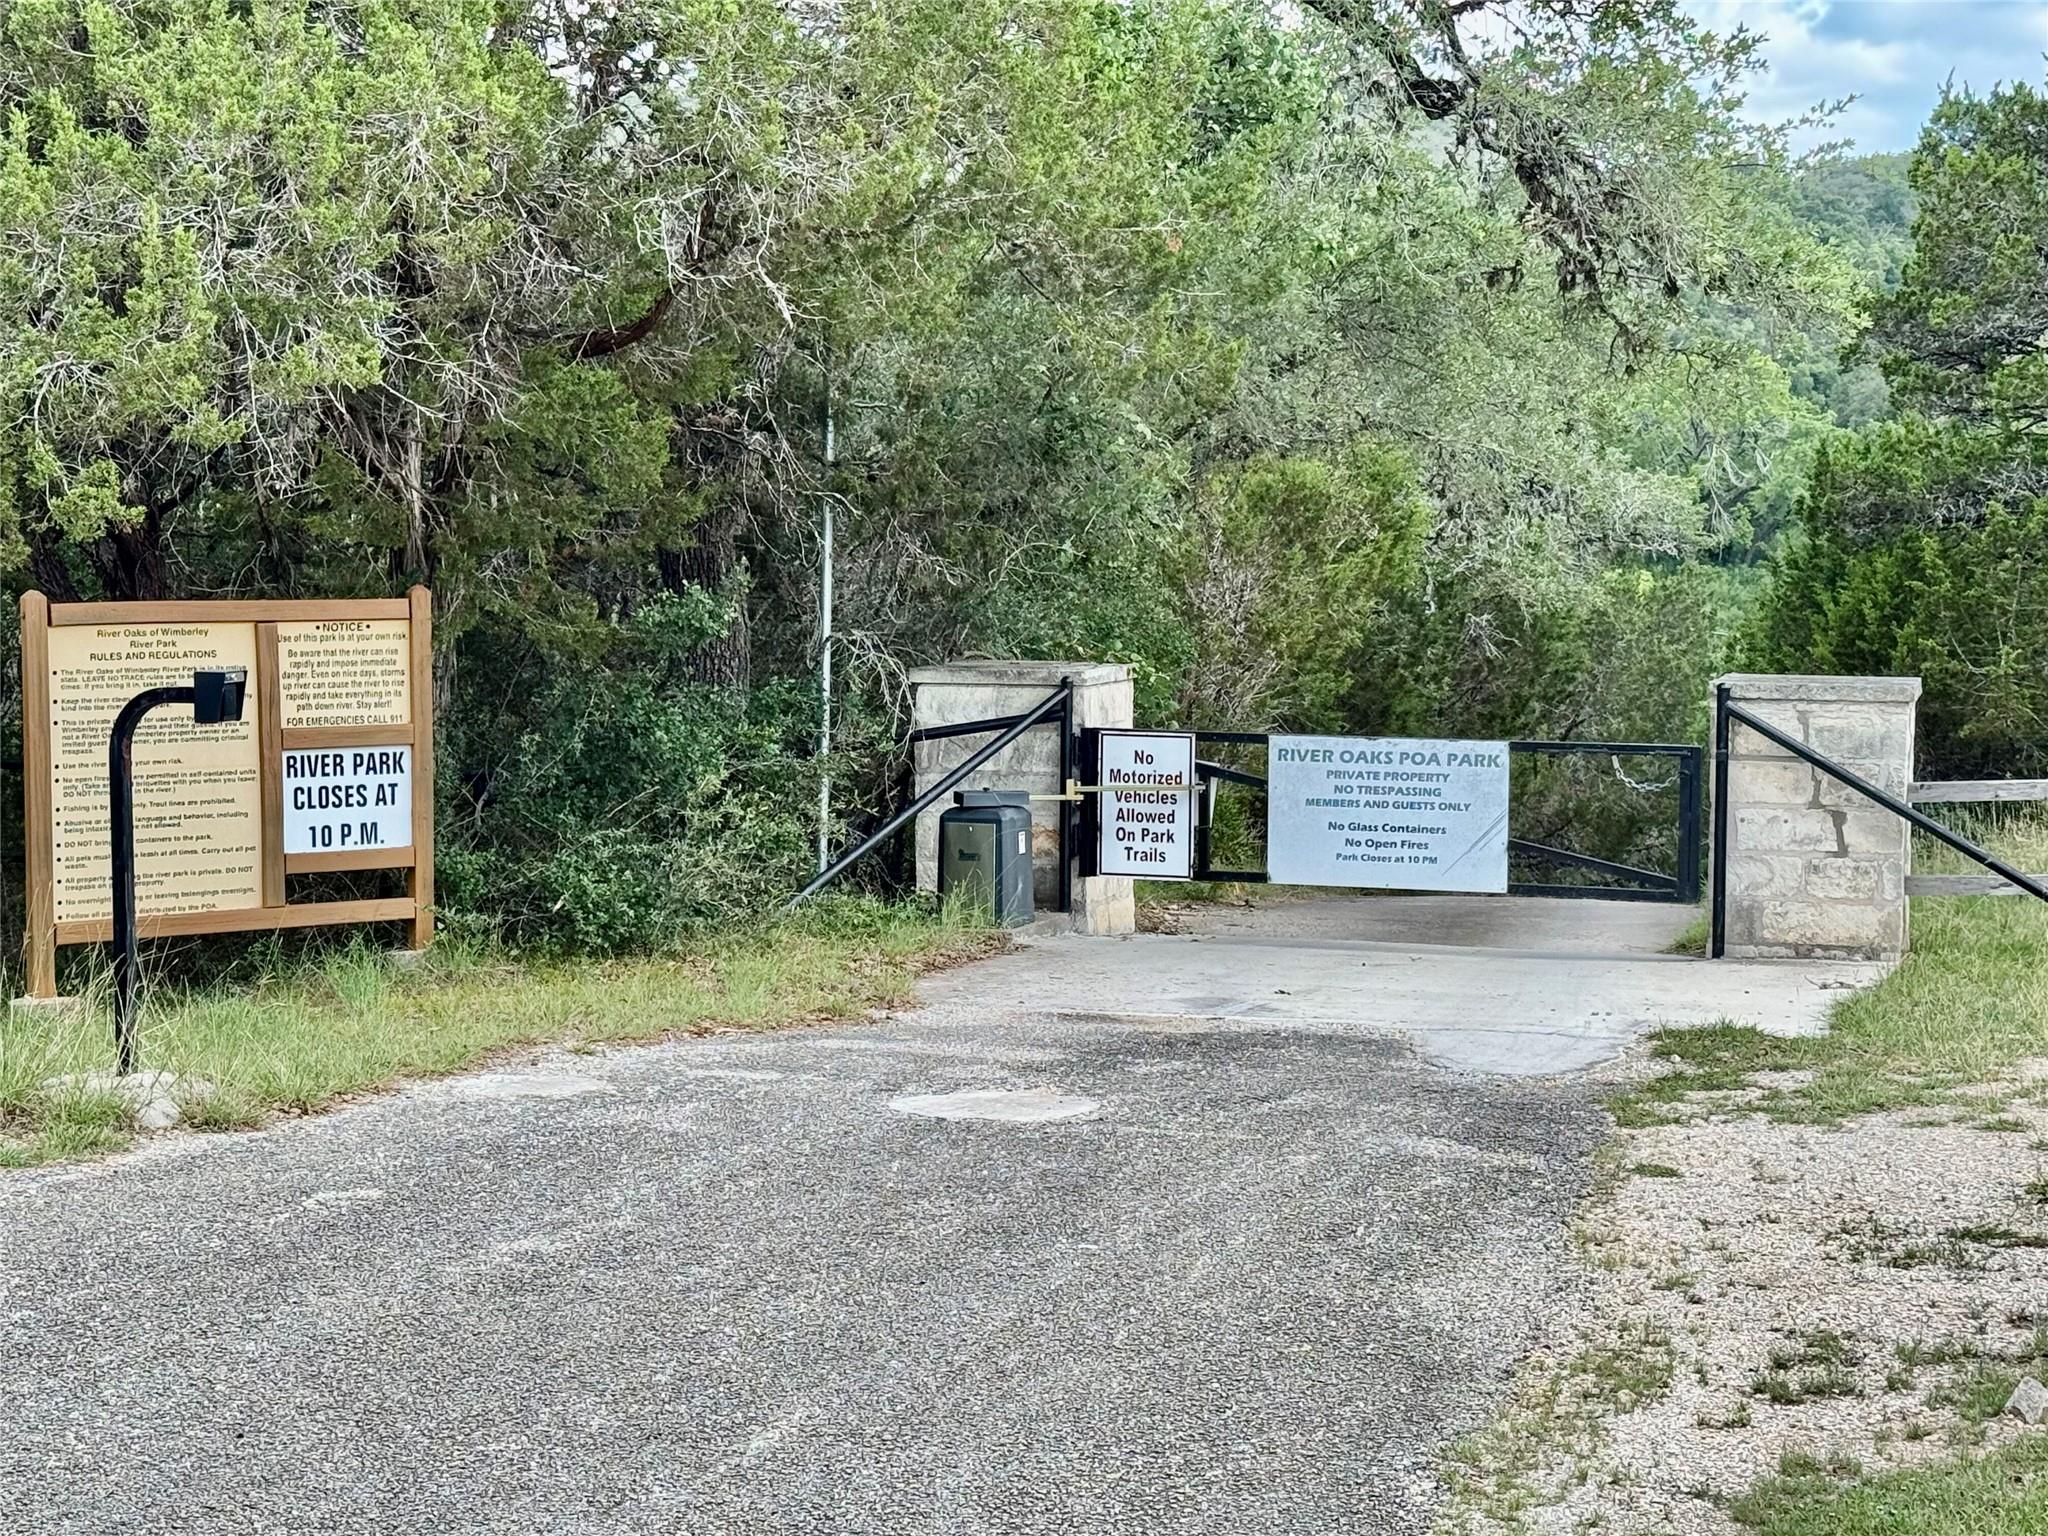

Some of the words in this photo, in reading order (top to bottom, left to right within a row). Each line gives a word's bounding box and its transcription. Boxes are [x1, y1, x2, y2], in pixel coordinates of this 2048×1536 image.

[323, 622, 364, 631] NOTICE
[97, 629, 121, 638] River
[124, 629, 147, 637] Oaks
[149, 628, 159, 636] of
[160, 628, 209, 637] Wimberley
[277, 634, 292, 643] Use
[294, 634, 301, 642] of
[303, 633, 318, 642] this
[320, 633, 336, 643] park
[338, 632, 345, 641] is
[347, 633, 354, 641] at
[356, 634, 373, 642] your
[130, 640, 153, 648] River
[90, 652, 122, 661] RULES
[125, 652, 146, 660] AND
[148, 650, 217, 659] REGULATIONS
[288, 649, 298, 657] Be
[339, 648, 350, 656] the
[353, 648, 368, 656] river
[290, 660, 314, 669] rapidly
[316, 660, 330, 668] and
[332, 659, 358, 668] impose
[360, 657, 397, 666] immediate
[282, 671, 308, 680] danger.
[311, 670, 329, 678] Even
[342, 669, 358, 677] nice
[380, 668, 405, 676] storms
[282, 682, 292, 690] up
[294, 681, 310, 689] river
[351, 680, 362, 688] the
[286, 692, 310, 701] rapidly
[312, 691, 326, 699] and
[328, 690, 343, 699] take
[345, 690, 383, 700] everything
[393, 689, 402, 697] its
[296, 703, 313, 712] path
[315, 702, 334, 710] down
[356, 701, 372, 710] Stay
[374, 700, 392, 708] alert!
[287, 718, 304, 726] FOR
[306, 716, 365, 726] EMERGENCIES
[367, 715, 388, 724] CALL
[390, 714, 403, 722] 911
[1134, 750, 1154, 765] No
[1278, 749, 1334, 763] RIVER
[1339, 750, 1394, 764] OAKS
[1399, 752, 1441, 766] POA
[1447, 753, 1501, 768] PARK
[286, 754, 344, 778] RIVER
[353, 751, 404, 776] PARK
[1109, 768, 1183, 785] Motorized
[1326, 770, 1380, 780] PRIVATE
[1384, 772, 1450, 782] PROPERTY
[293, 784, 368, 810] CLOSES
[375, 783, 398, 806] AT
[1334, 785, 1353, 794] NO
[1356, 785, 1441, 797] TRESPASSING
[1115, 790, 1178, 805] Vehicles
[1305, 798, 1360, 808] MEMBERS
[1364, 800, 1389, 809] AND
[1392, 801, 1435, 810] GUESTS
[1438, 802, 1472, 812] ONLY
[135, 815, 167, 823] language
[217, 811, 249, 819] including
[1116, 807, 1175, 824] Allowed
[1328, 822, 1345, 831] No
[1348, 822, 1379, 832] Glass
[1382, 823, 1447, 834] Containers
[308, 825, 332, 848] 10
[341, 822, 384, 846] P.M.
[1116, 827, 1135, 842] On
[1141, 828, 1175, 843] Park
[1344, 838, 1362, 847] No
[1365, 839, 1397, 850] Open
[1400, 840, 1429, 850] Fires
[140, 850, 159, 858] leash
[201, 847, 220, 855] Carry
[1124, 846, 1166, 863] Trails
[1336, 853, 1358, 861] Park
[1361, 854, 1392, 862] Closes
[1408, 856, 1420, 864] 10
[1422, 856, 1438, 864] PM
[173, 870, 188, 878] park
